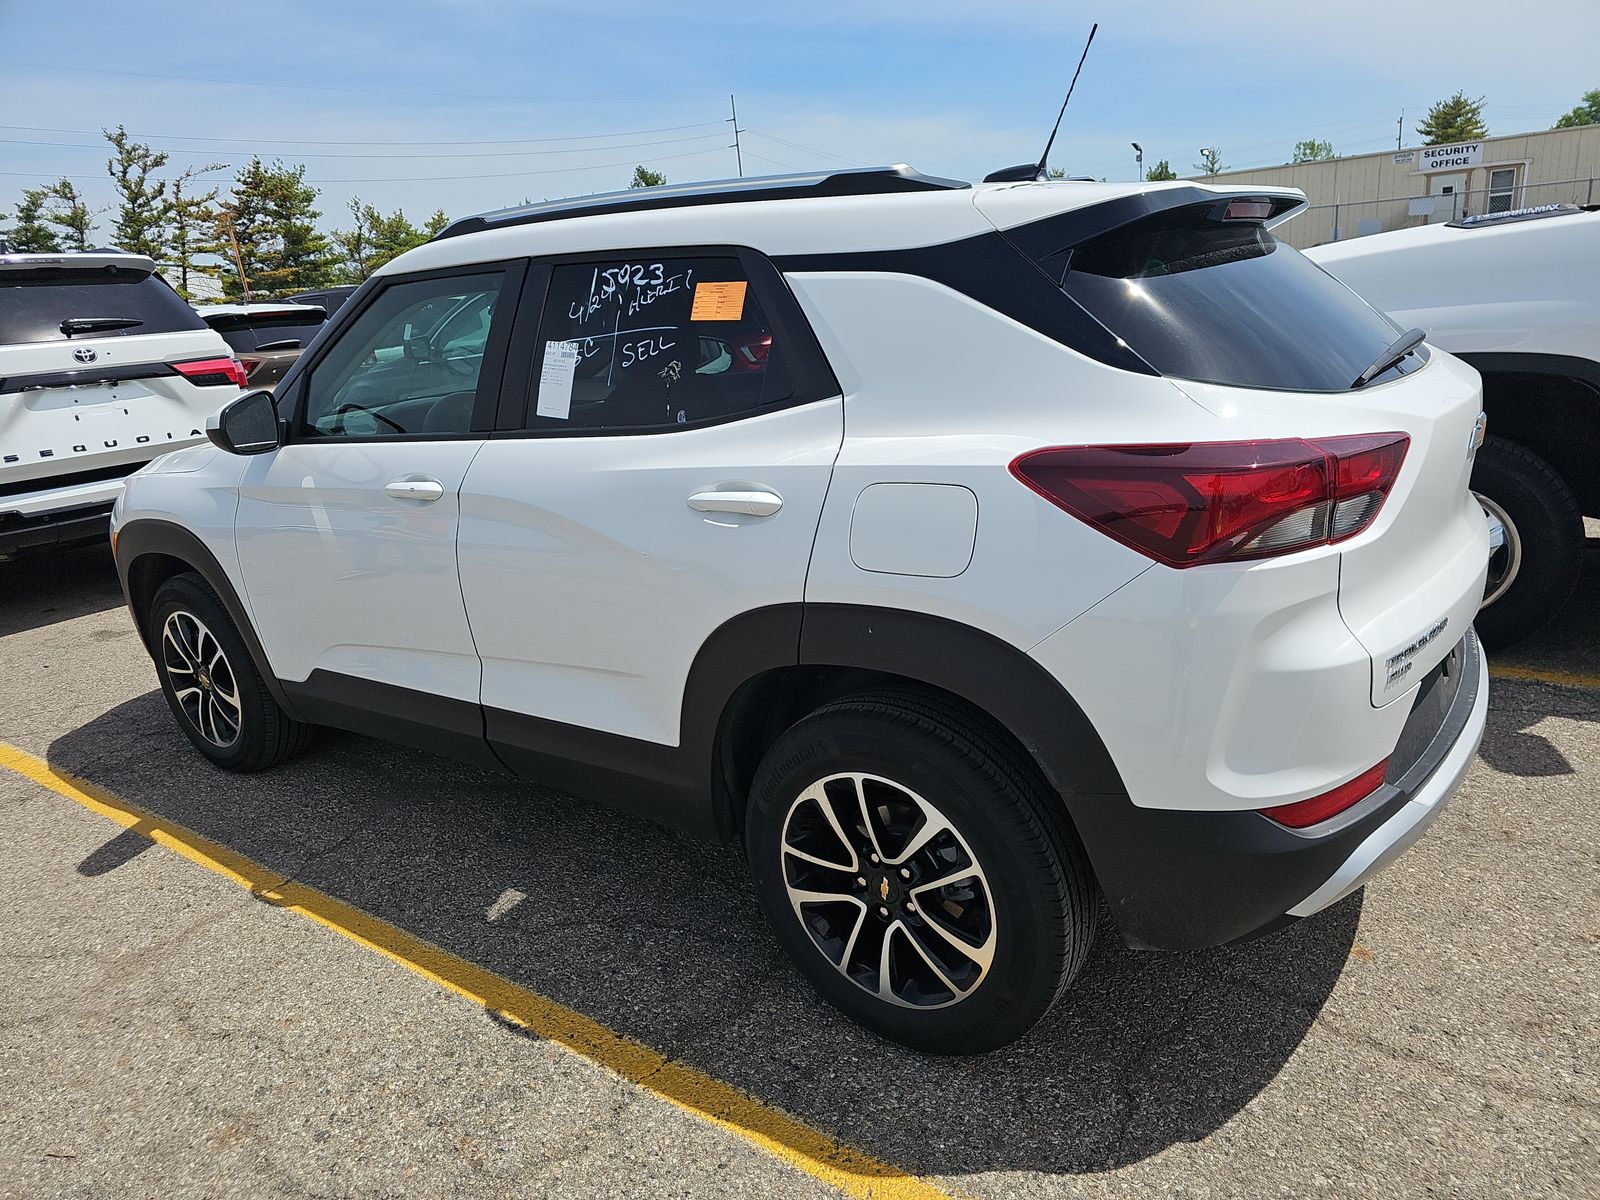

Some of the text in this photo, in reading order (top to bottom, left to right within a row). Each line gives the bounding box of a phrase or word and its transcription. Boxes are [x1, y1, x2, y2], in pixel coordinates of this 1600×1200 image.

[1423, 144, 1479, 158] SECURITY
[1430, 156, 1470, 168] OFFICE
[547, 341, 578, 353] 4114784
[622, 336, 677, 367] SELL
[3, 428, 202, 463] SEQUOIA
